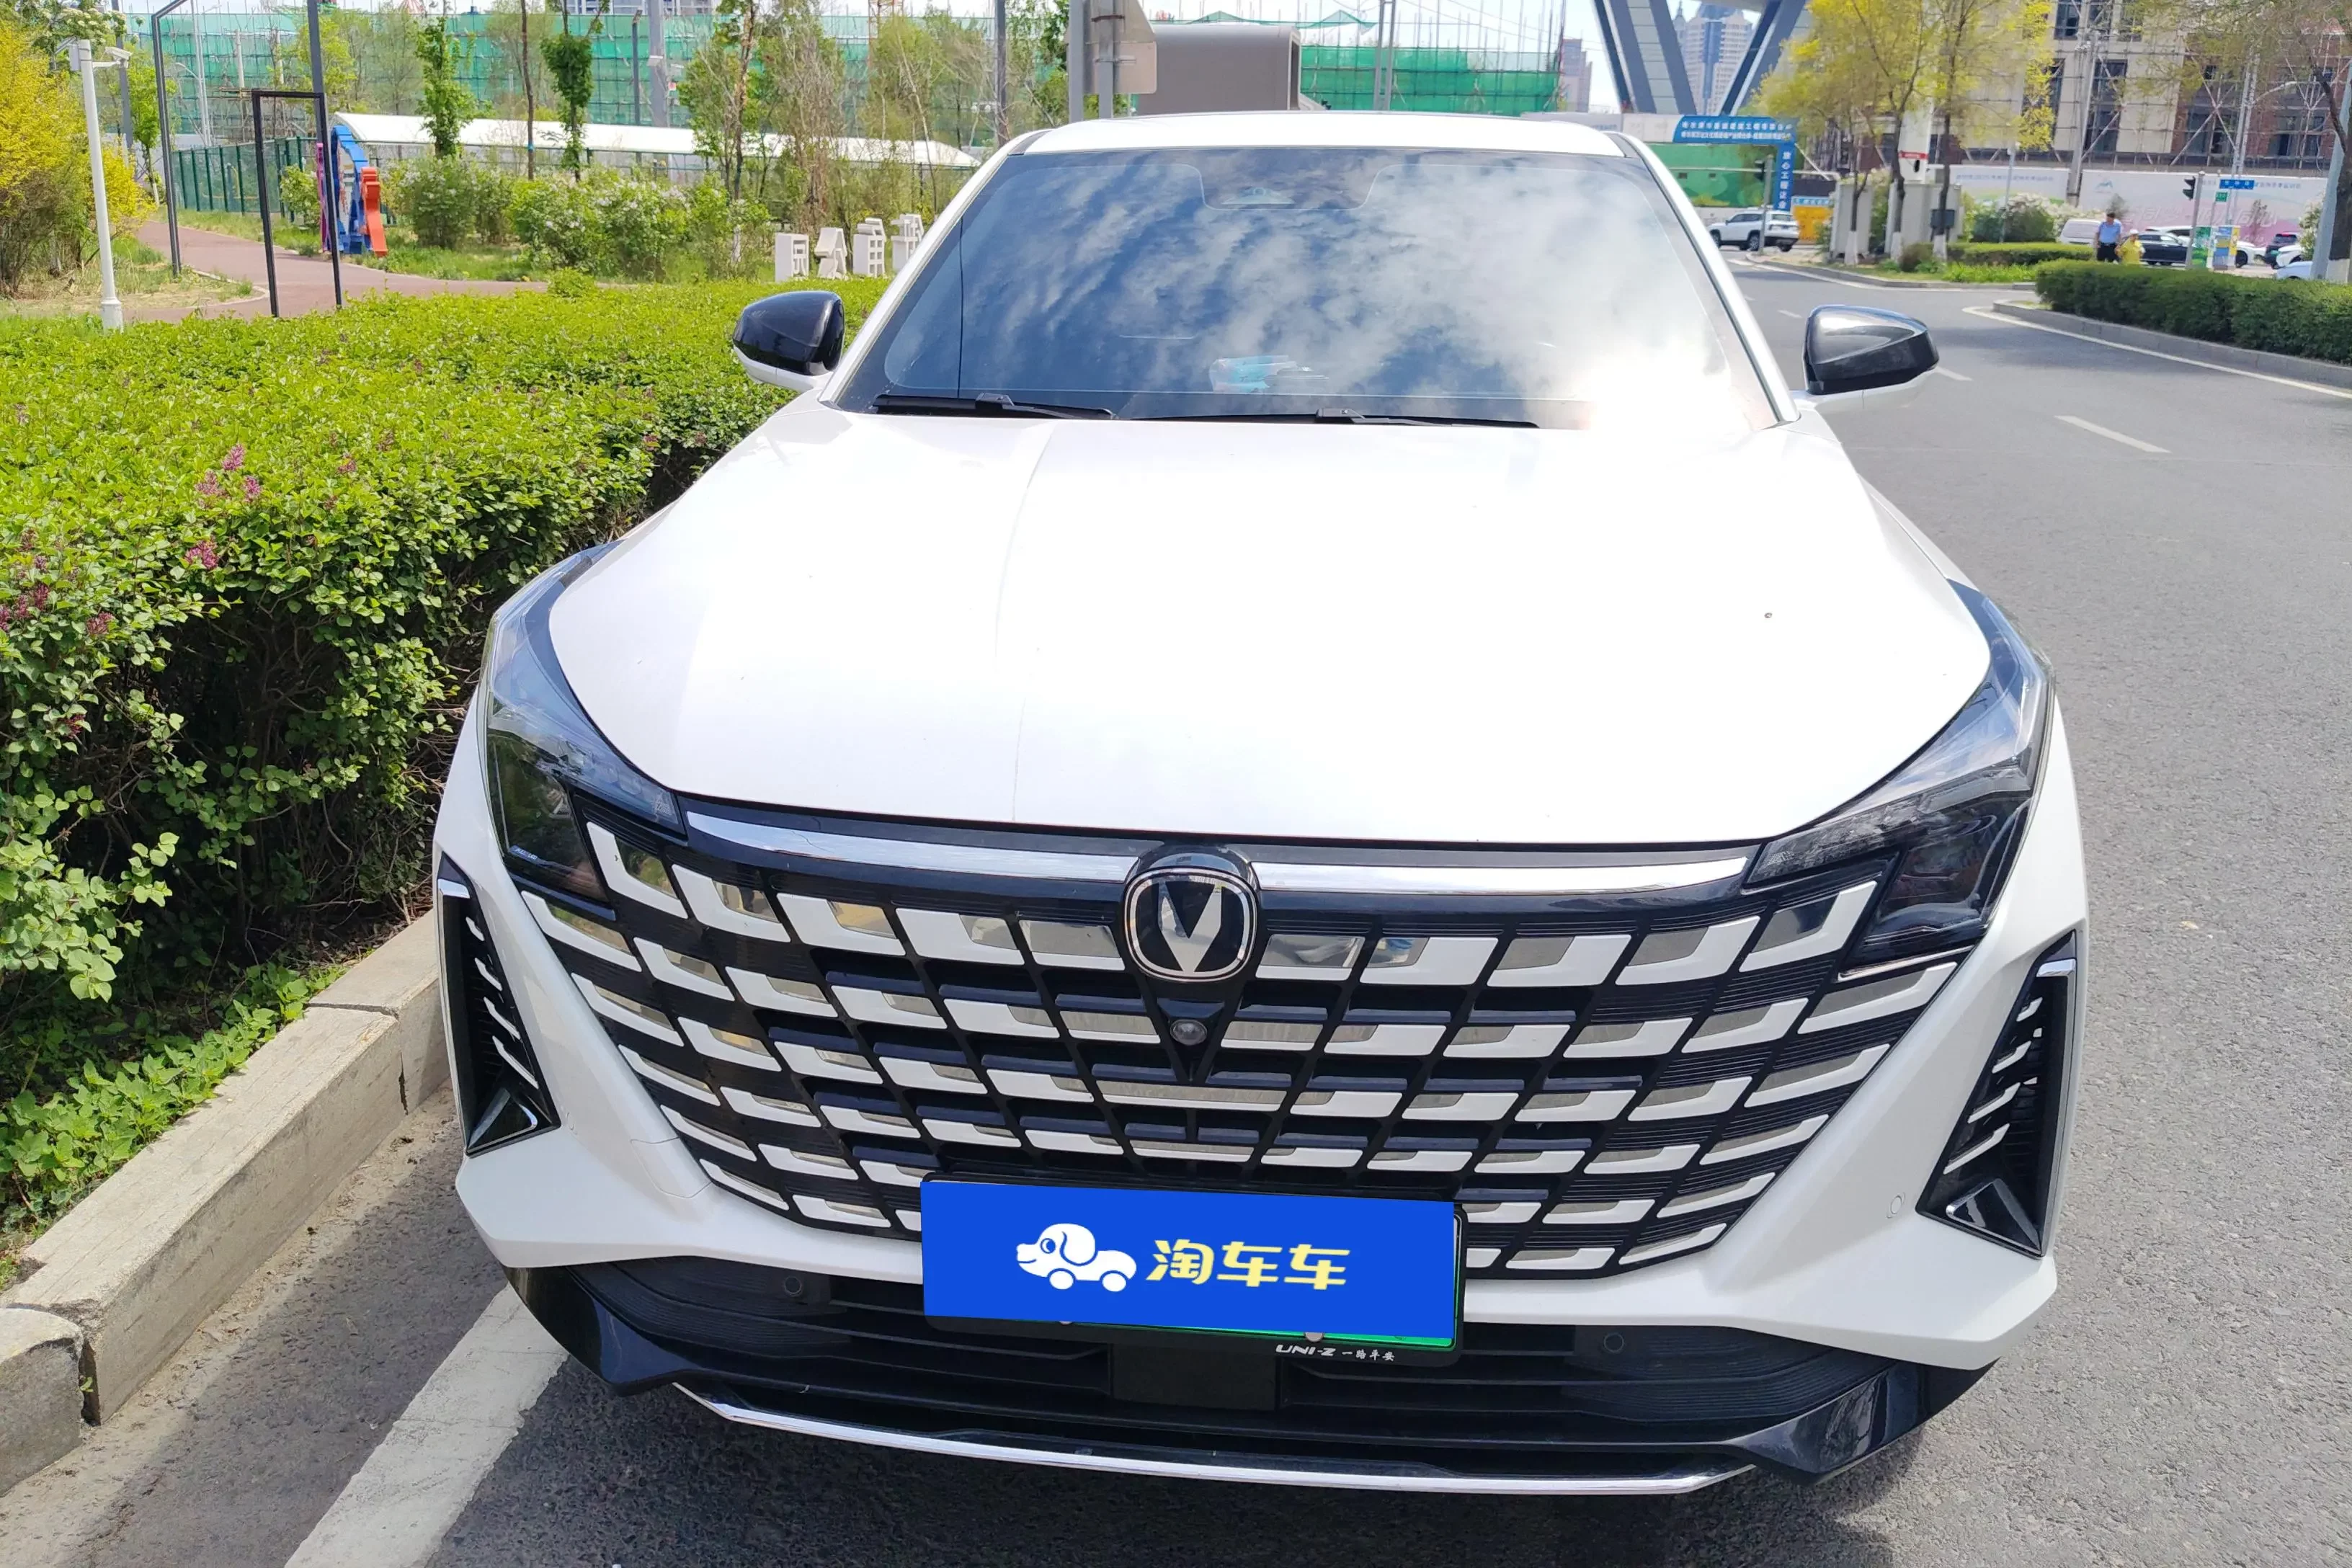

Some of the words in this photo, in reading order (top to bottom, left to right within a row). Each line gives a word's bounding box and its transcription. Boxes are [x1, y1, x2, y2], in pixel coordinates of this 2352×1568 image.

[1275, 1344, 1336, 1356] UNI-Z
[1342, 1349, 1395, 1361] 一路平安
